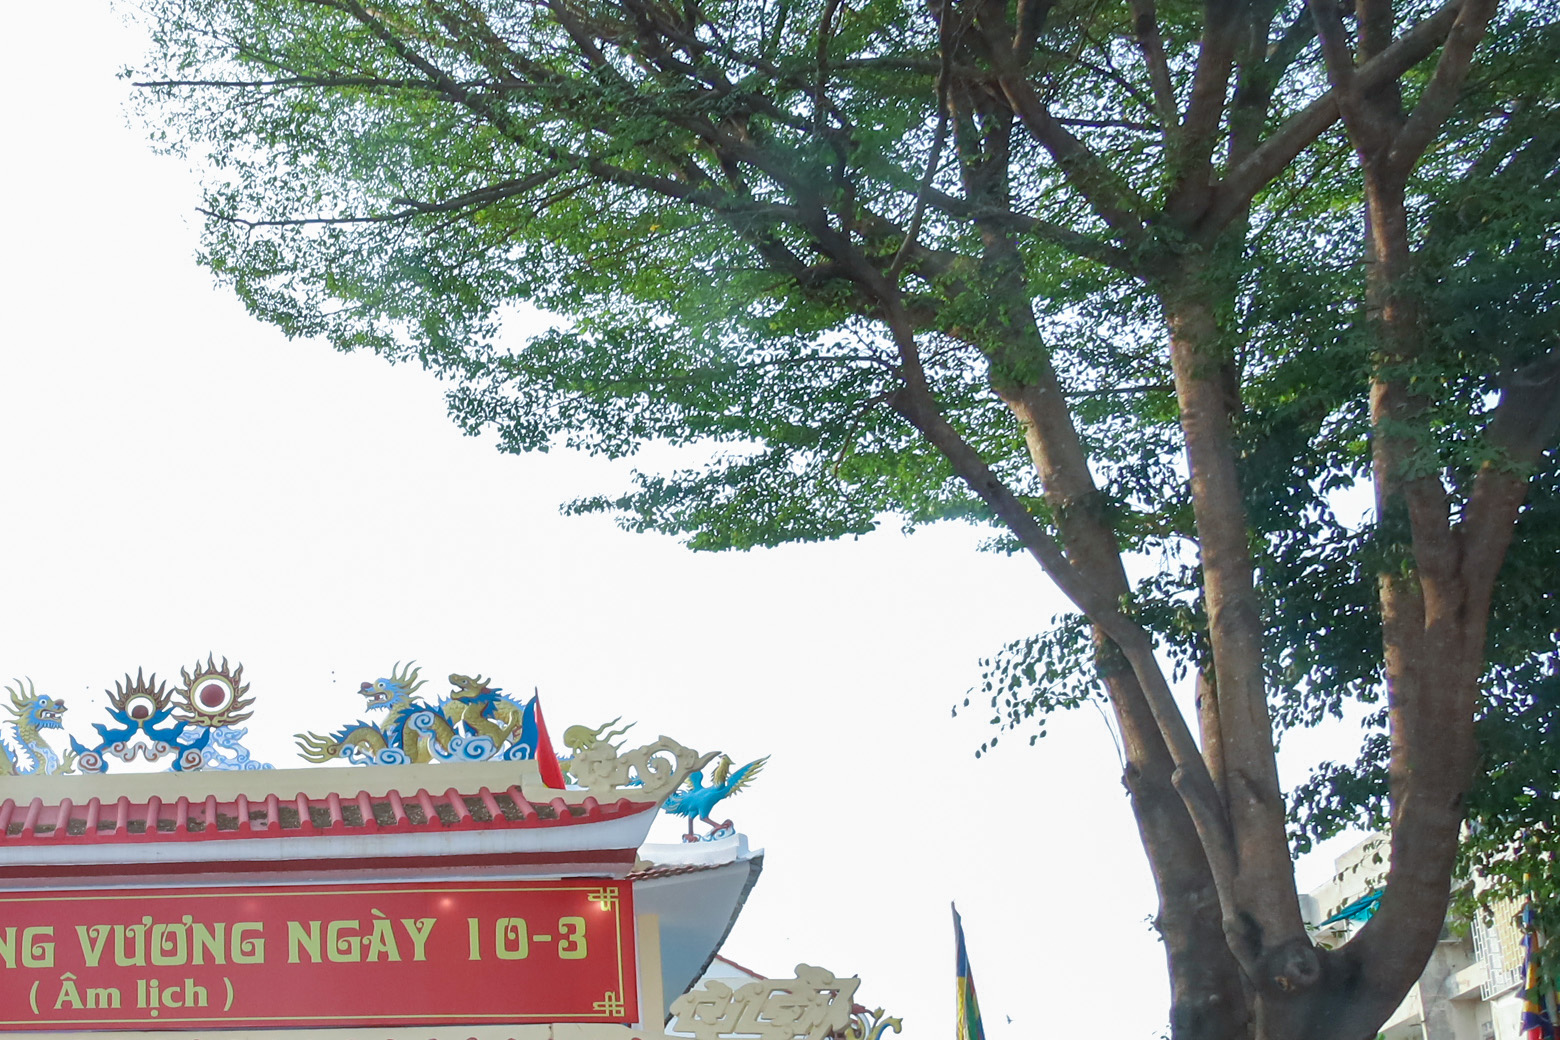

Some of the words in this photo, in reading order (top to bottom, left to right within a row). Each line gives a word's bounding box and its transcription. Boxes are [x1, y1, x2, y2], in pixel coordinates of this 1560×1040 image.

[76, 914, 266, 968] VƯƠNG
[287, 909, 438, 963] NGÀY
[468, 916, 588, 960] 10-3
